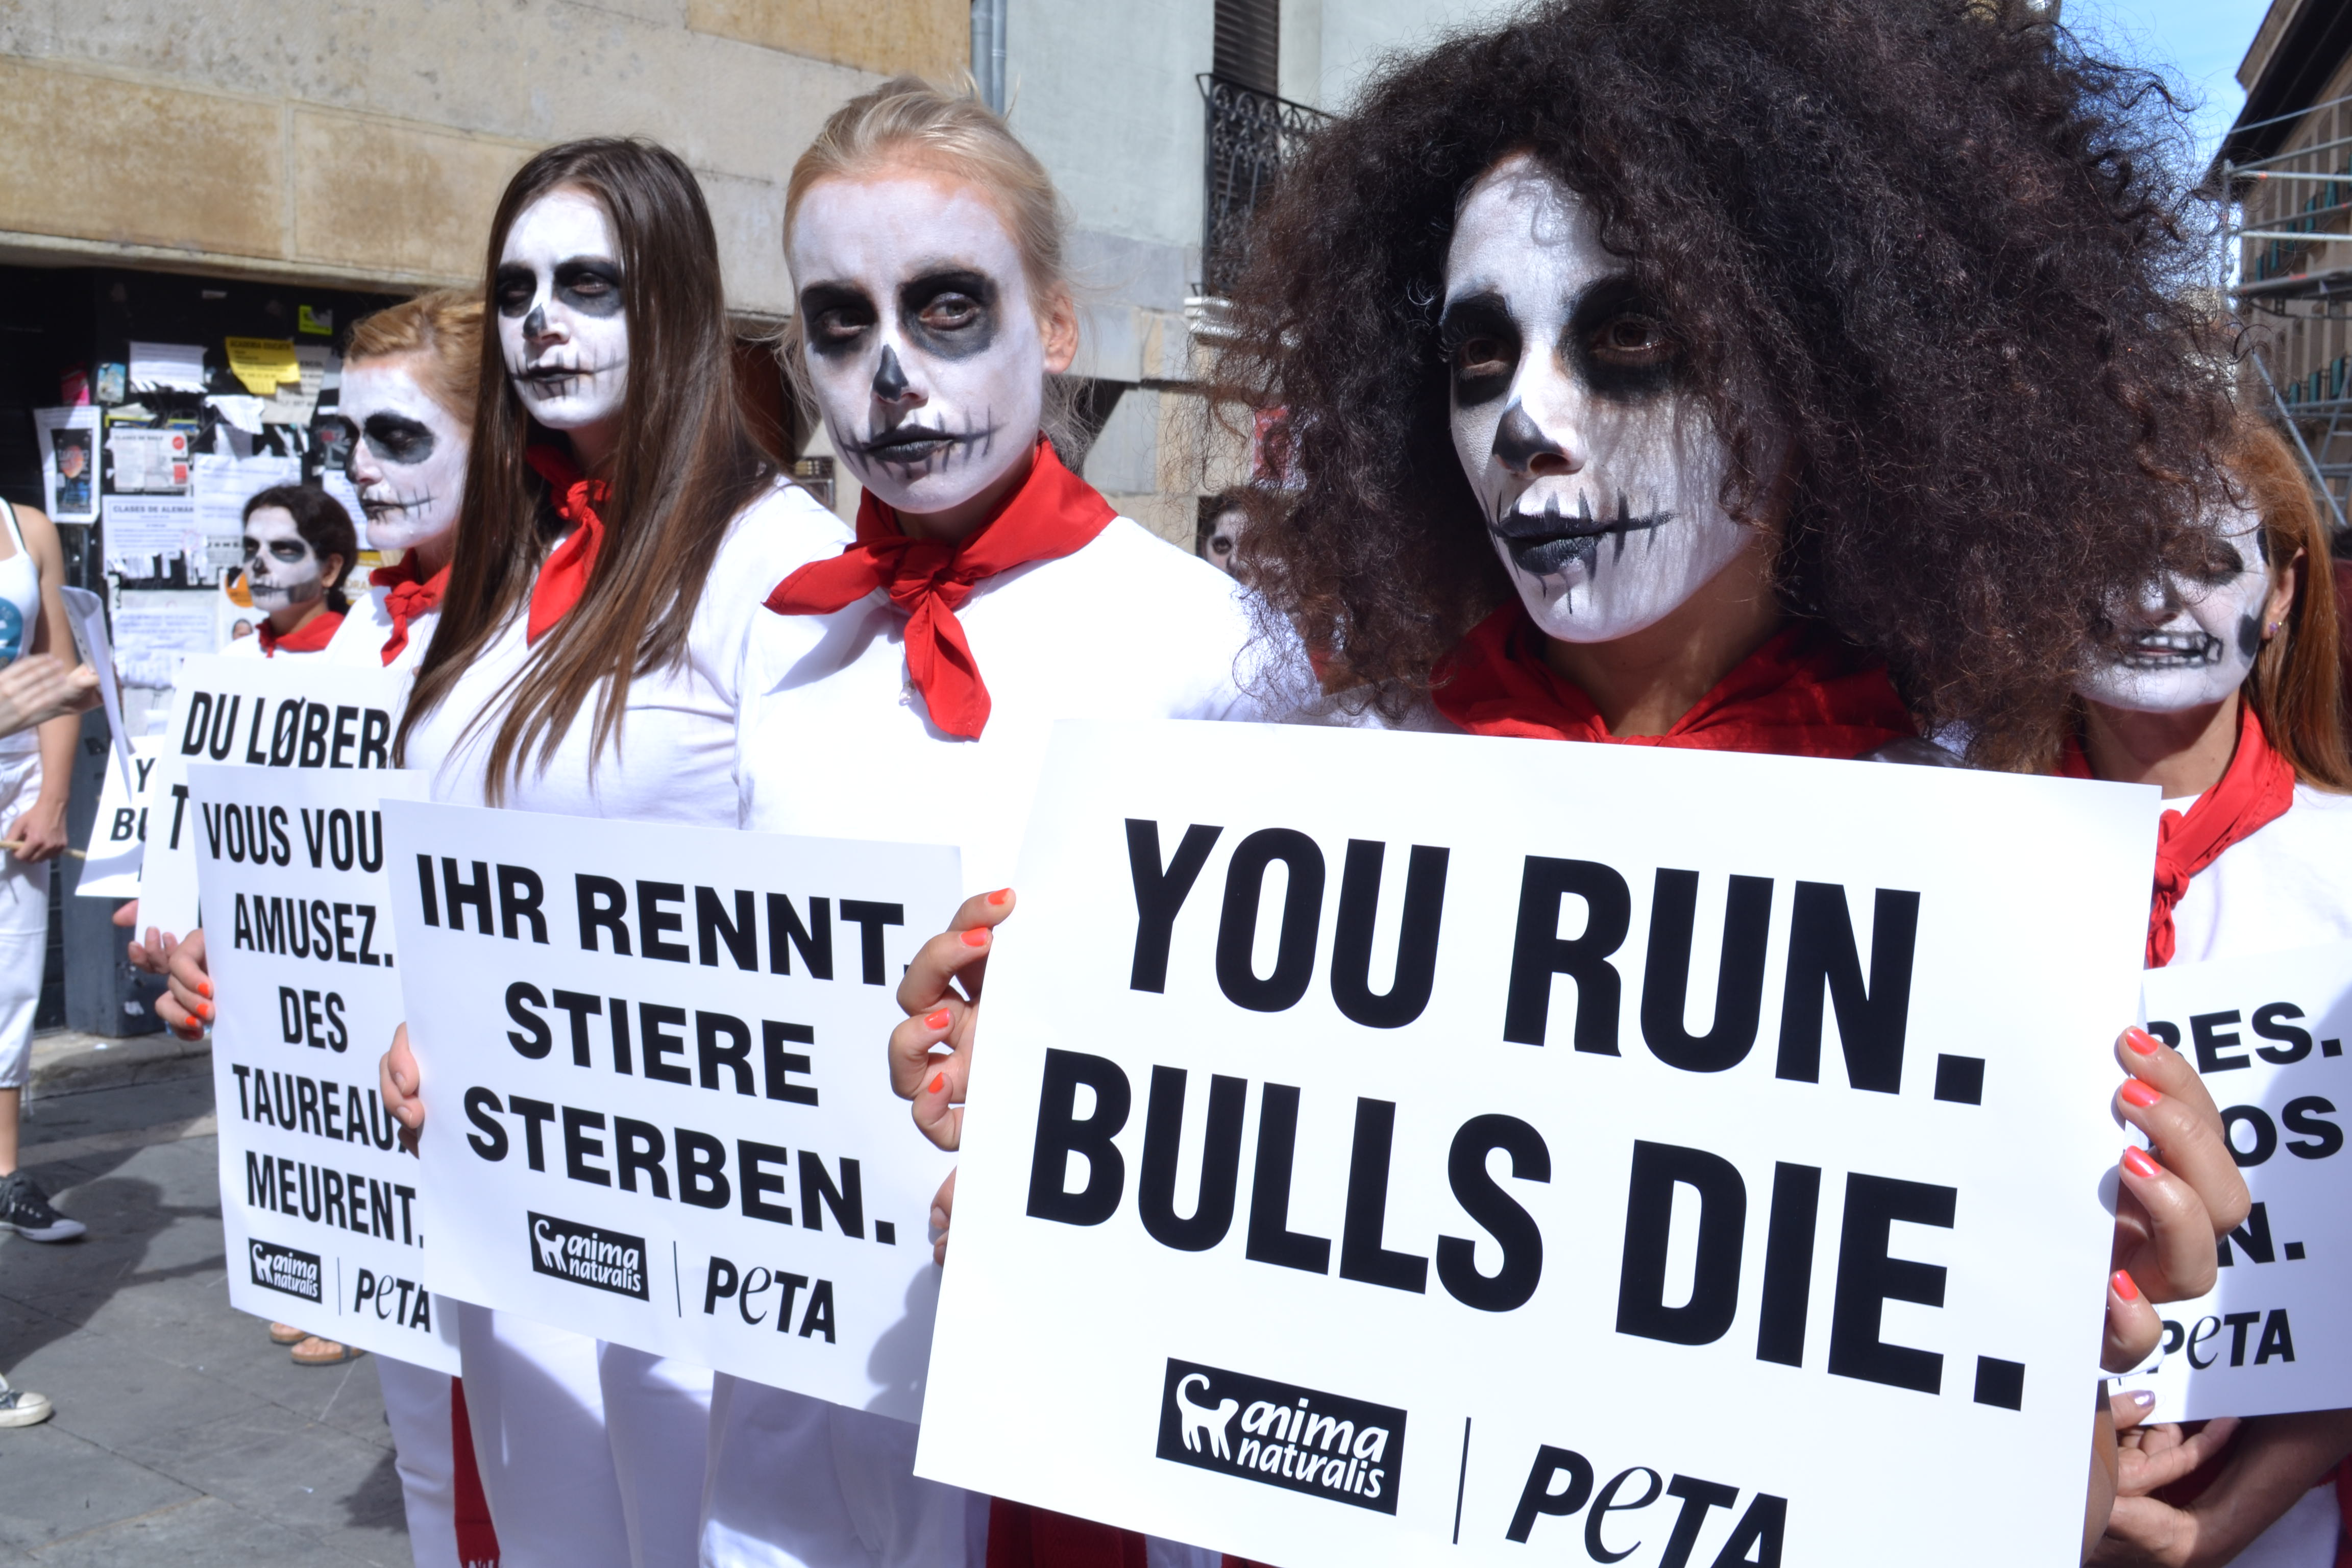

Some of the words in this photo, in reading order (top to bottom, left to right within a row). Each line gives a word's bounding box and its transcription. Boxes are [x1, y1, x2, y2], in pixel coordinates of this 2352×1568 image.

[181, 692, 240, 761] DU
[246, 697, 390, 768] LØBER
[202, 802, 291, 867] VOUS
[300, 808, 383, 873] VOU
[234, 893, 394, 967] AMUSEZ.
[416, 853, 550, 944] IHR
[1124, 818, 1450, 1029] YOU
[1503, 855, 1986, 1106] RUN.
[279, 986, 348, 1053] DES
[505, 982, 819, 1107] STIERE
[232, 1063, 407, 1154] TAUREAU
[464, 1086, 896, 1245] STERBEN.
[567, 1233, 639, 1270] anima
[1026, 1047, 1551, 1312] BULLS
[1615, 1139, 2025, 1411] DIE.
[273, 1252, 317, 1281] anima
[274, 1272, 318, 1297] naturalis
[569, 1258, 642, 1292] naturalis
[1241, 1398, 1389, 1463] anima
[1236, 1437, 1385, 1499] naturalis
